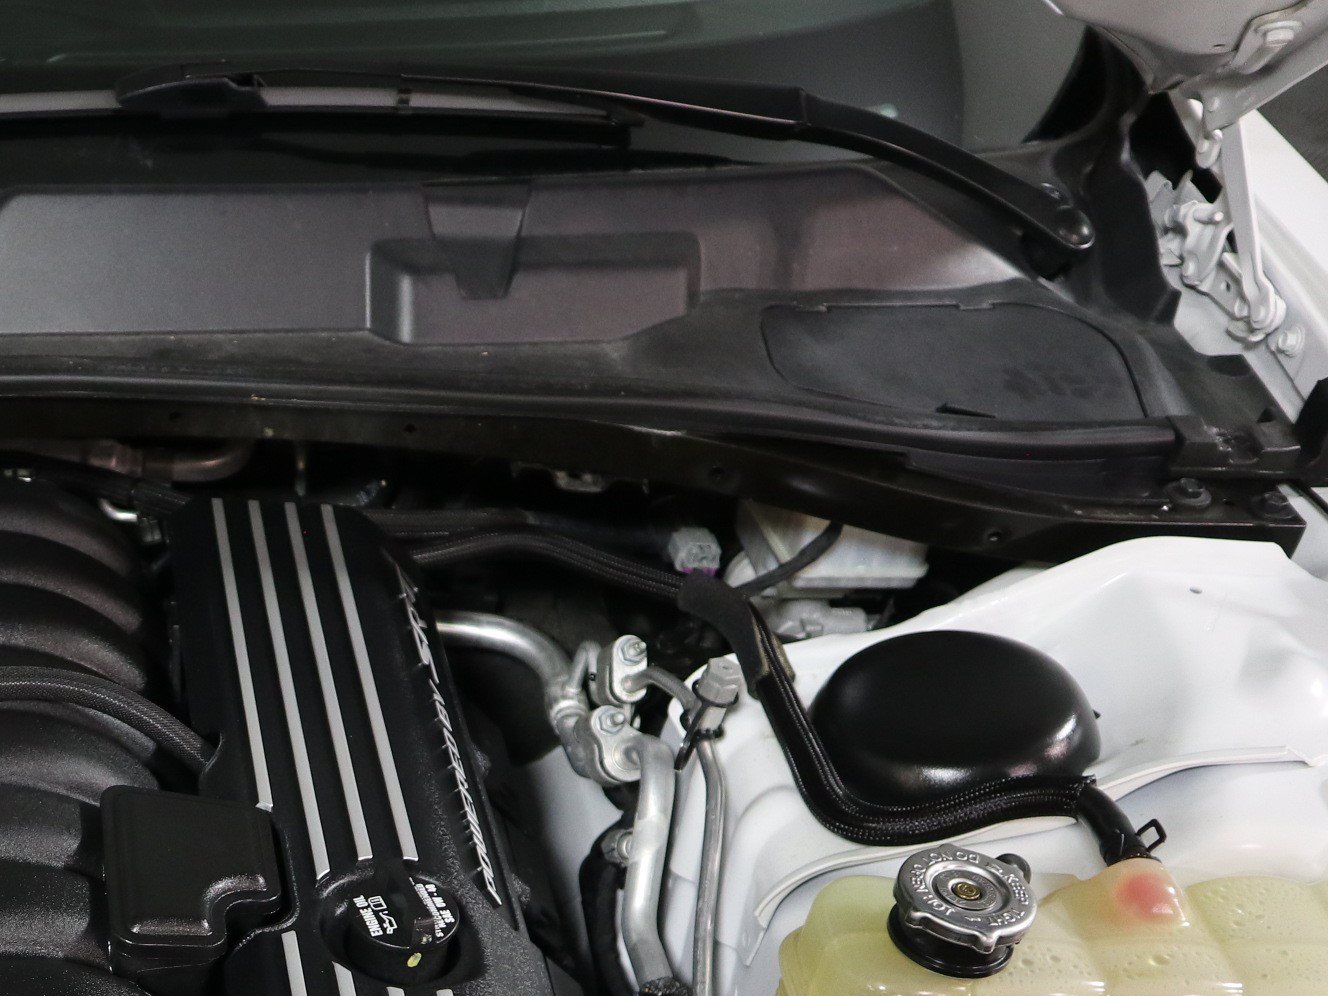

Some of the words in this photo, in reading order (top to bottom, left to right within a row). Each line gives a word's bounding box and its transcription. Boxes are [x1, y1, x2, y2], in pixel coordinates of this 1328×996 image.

[956, 851, 980, 864] DO
[353, 895, 368, 908] OIL
[359, 907, 383, 936] ENGINE
[440, 909, 455, 923] SAE
